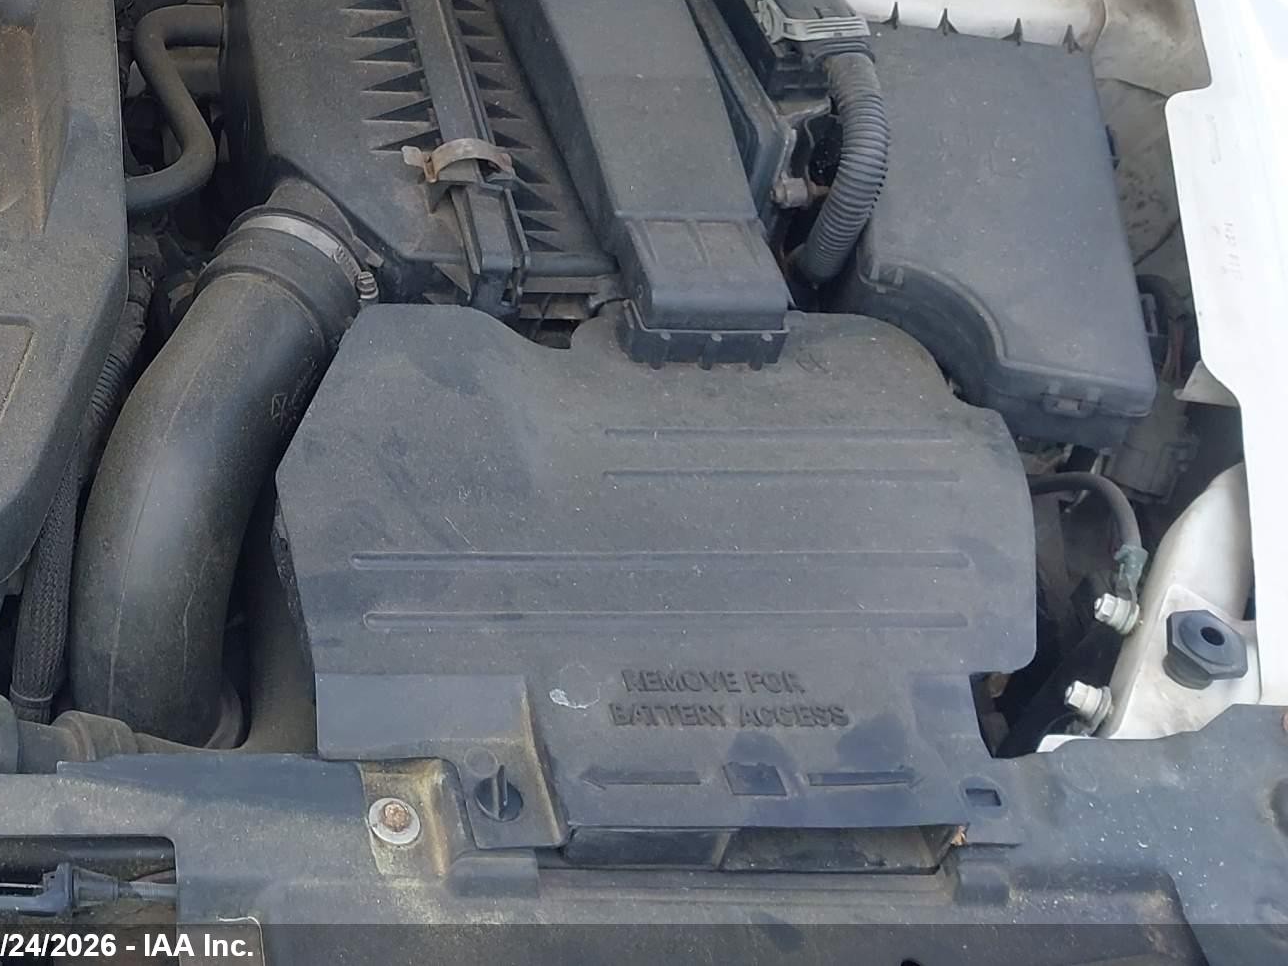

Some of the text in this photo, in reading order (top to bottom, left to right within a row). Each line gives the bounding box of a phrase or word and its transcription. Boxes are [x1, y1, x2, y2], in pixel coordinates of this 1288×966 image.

[621, 668, 806, 694] REMOVE FOR
[608, 702, 851, 728] BATTERY ACCESS
